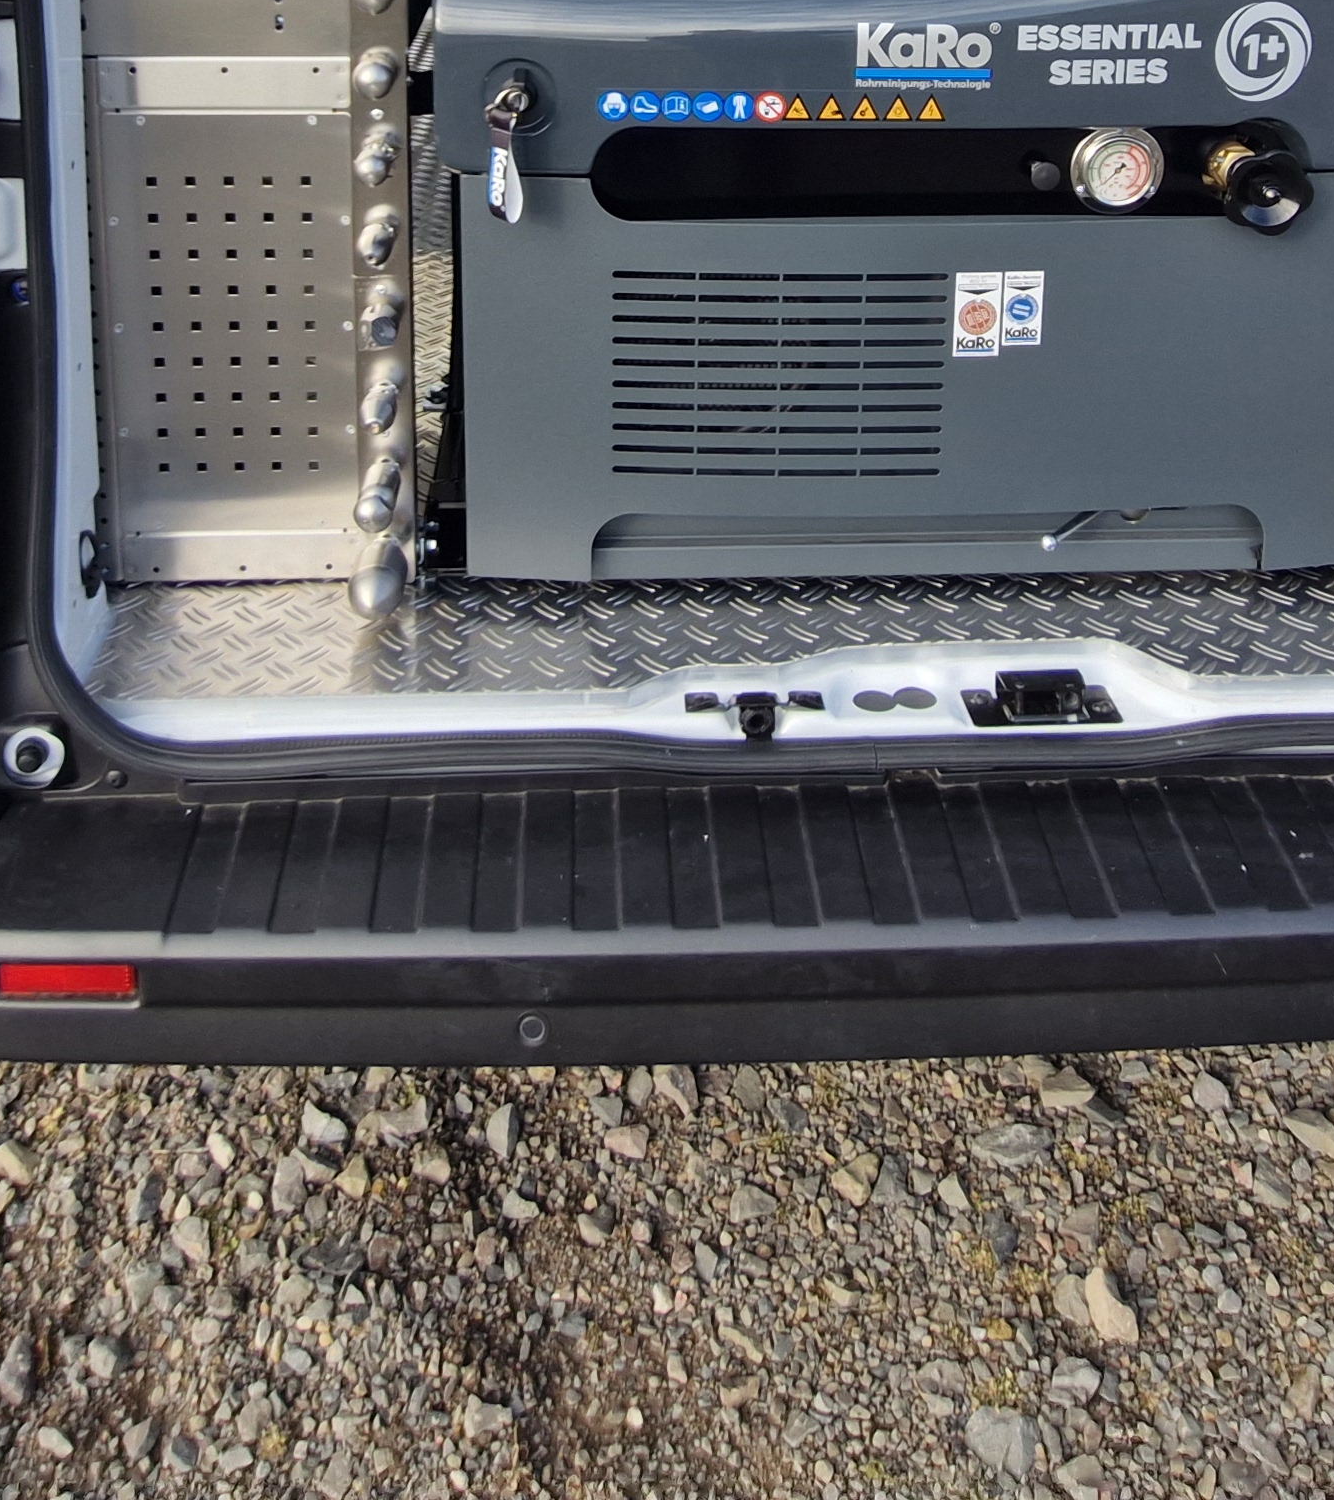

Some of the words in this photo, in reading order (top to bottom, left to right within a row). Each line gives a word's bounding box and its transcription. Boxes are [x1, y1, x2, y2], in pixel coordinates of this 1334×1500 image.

[1017, 23, 1203, 51] ESSENTIAL
[1242, 31, 1286, 71] 1+
[855, 78, 992, 90] Rohrreinigungs-Technologie
[1048, 58, 1168, 86] SERIES
[490, 146, 508, 207] KaRo
[956, 336, 995, 350] KaRo
[1005, 327, 1038, 338] KaRo
